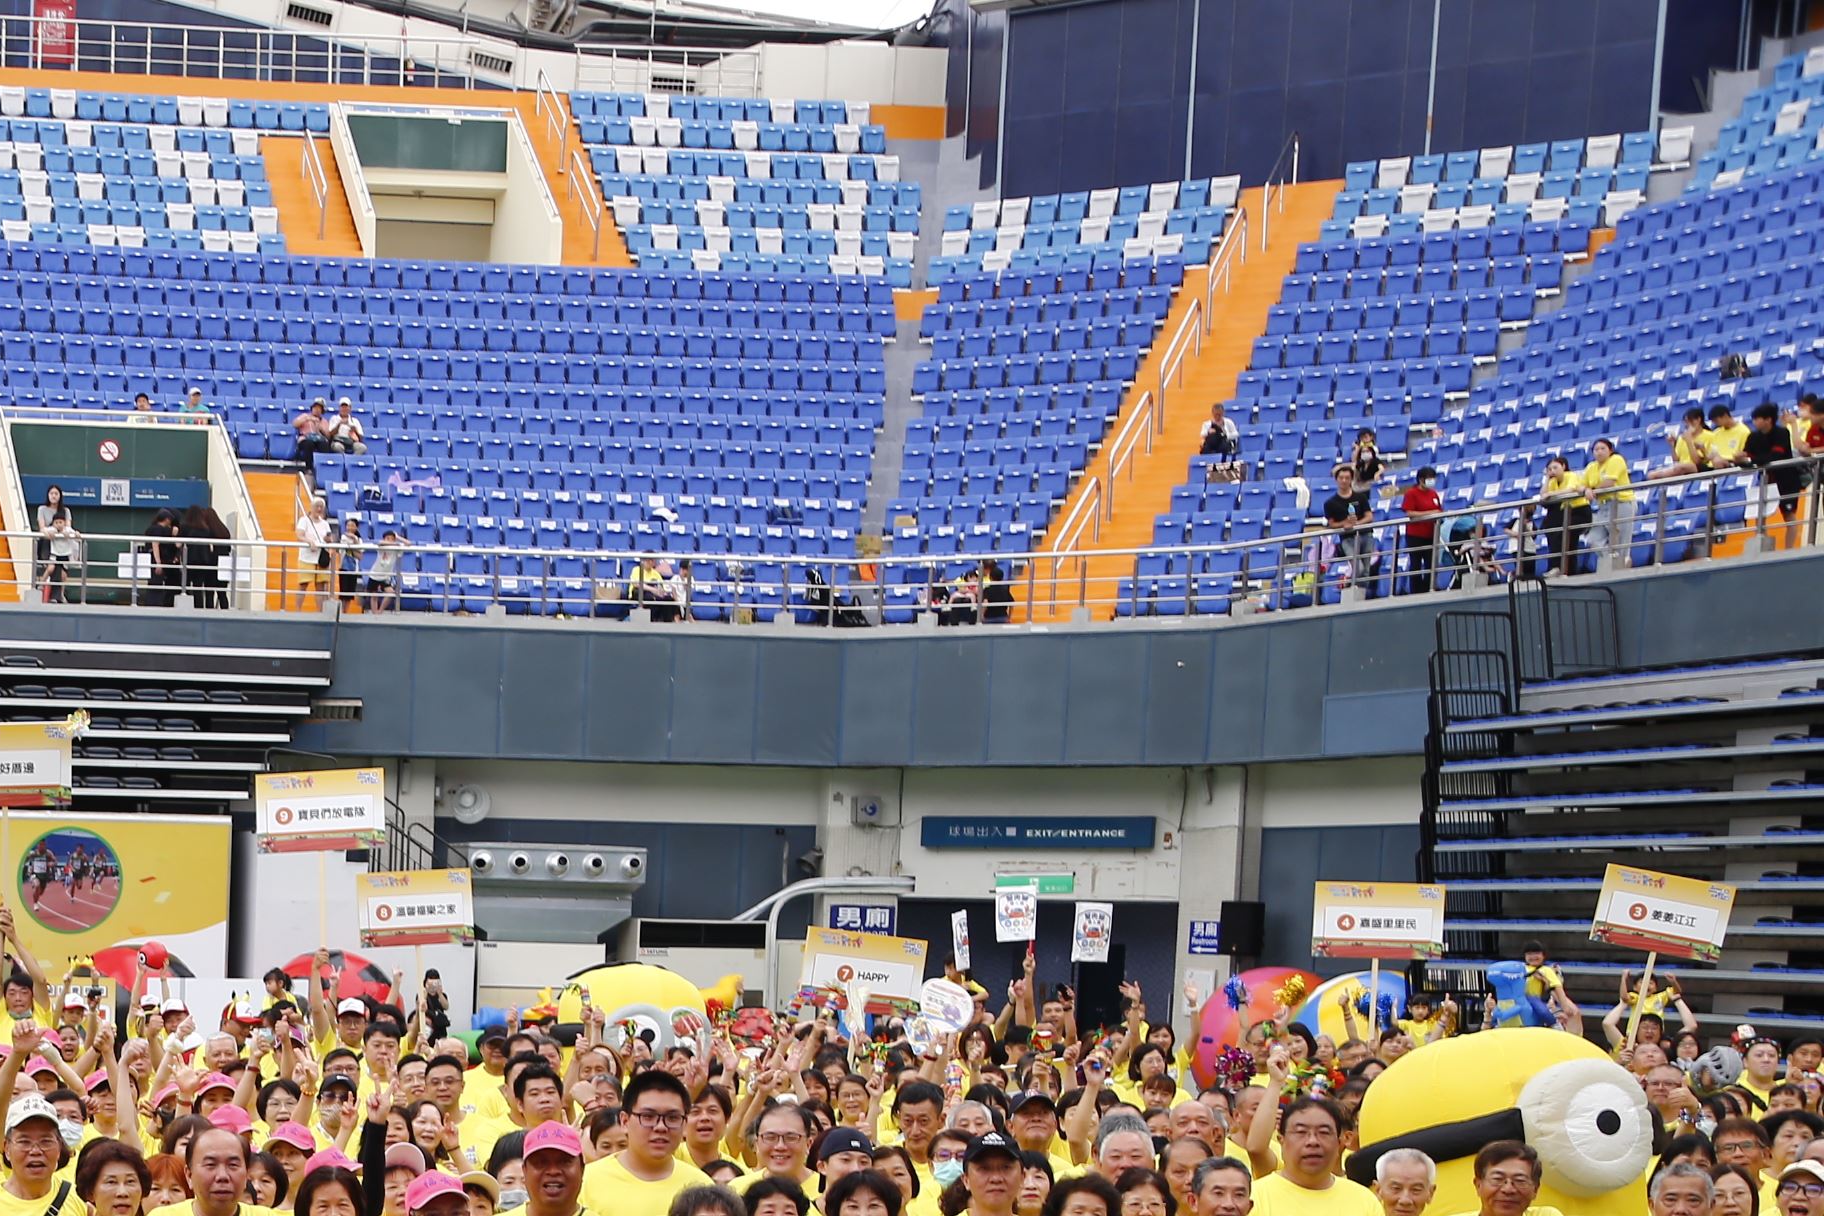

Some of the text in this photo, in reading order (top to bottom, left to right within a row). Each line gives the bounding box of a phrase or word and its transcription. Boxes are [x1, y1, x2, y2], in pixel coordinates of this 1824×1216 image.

[298, 806, 366, 822] 寶貝們放電隊
[857, 971, 890, 983] HAPPY
